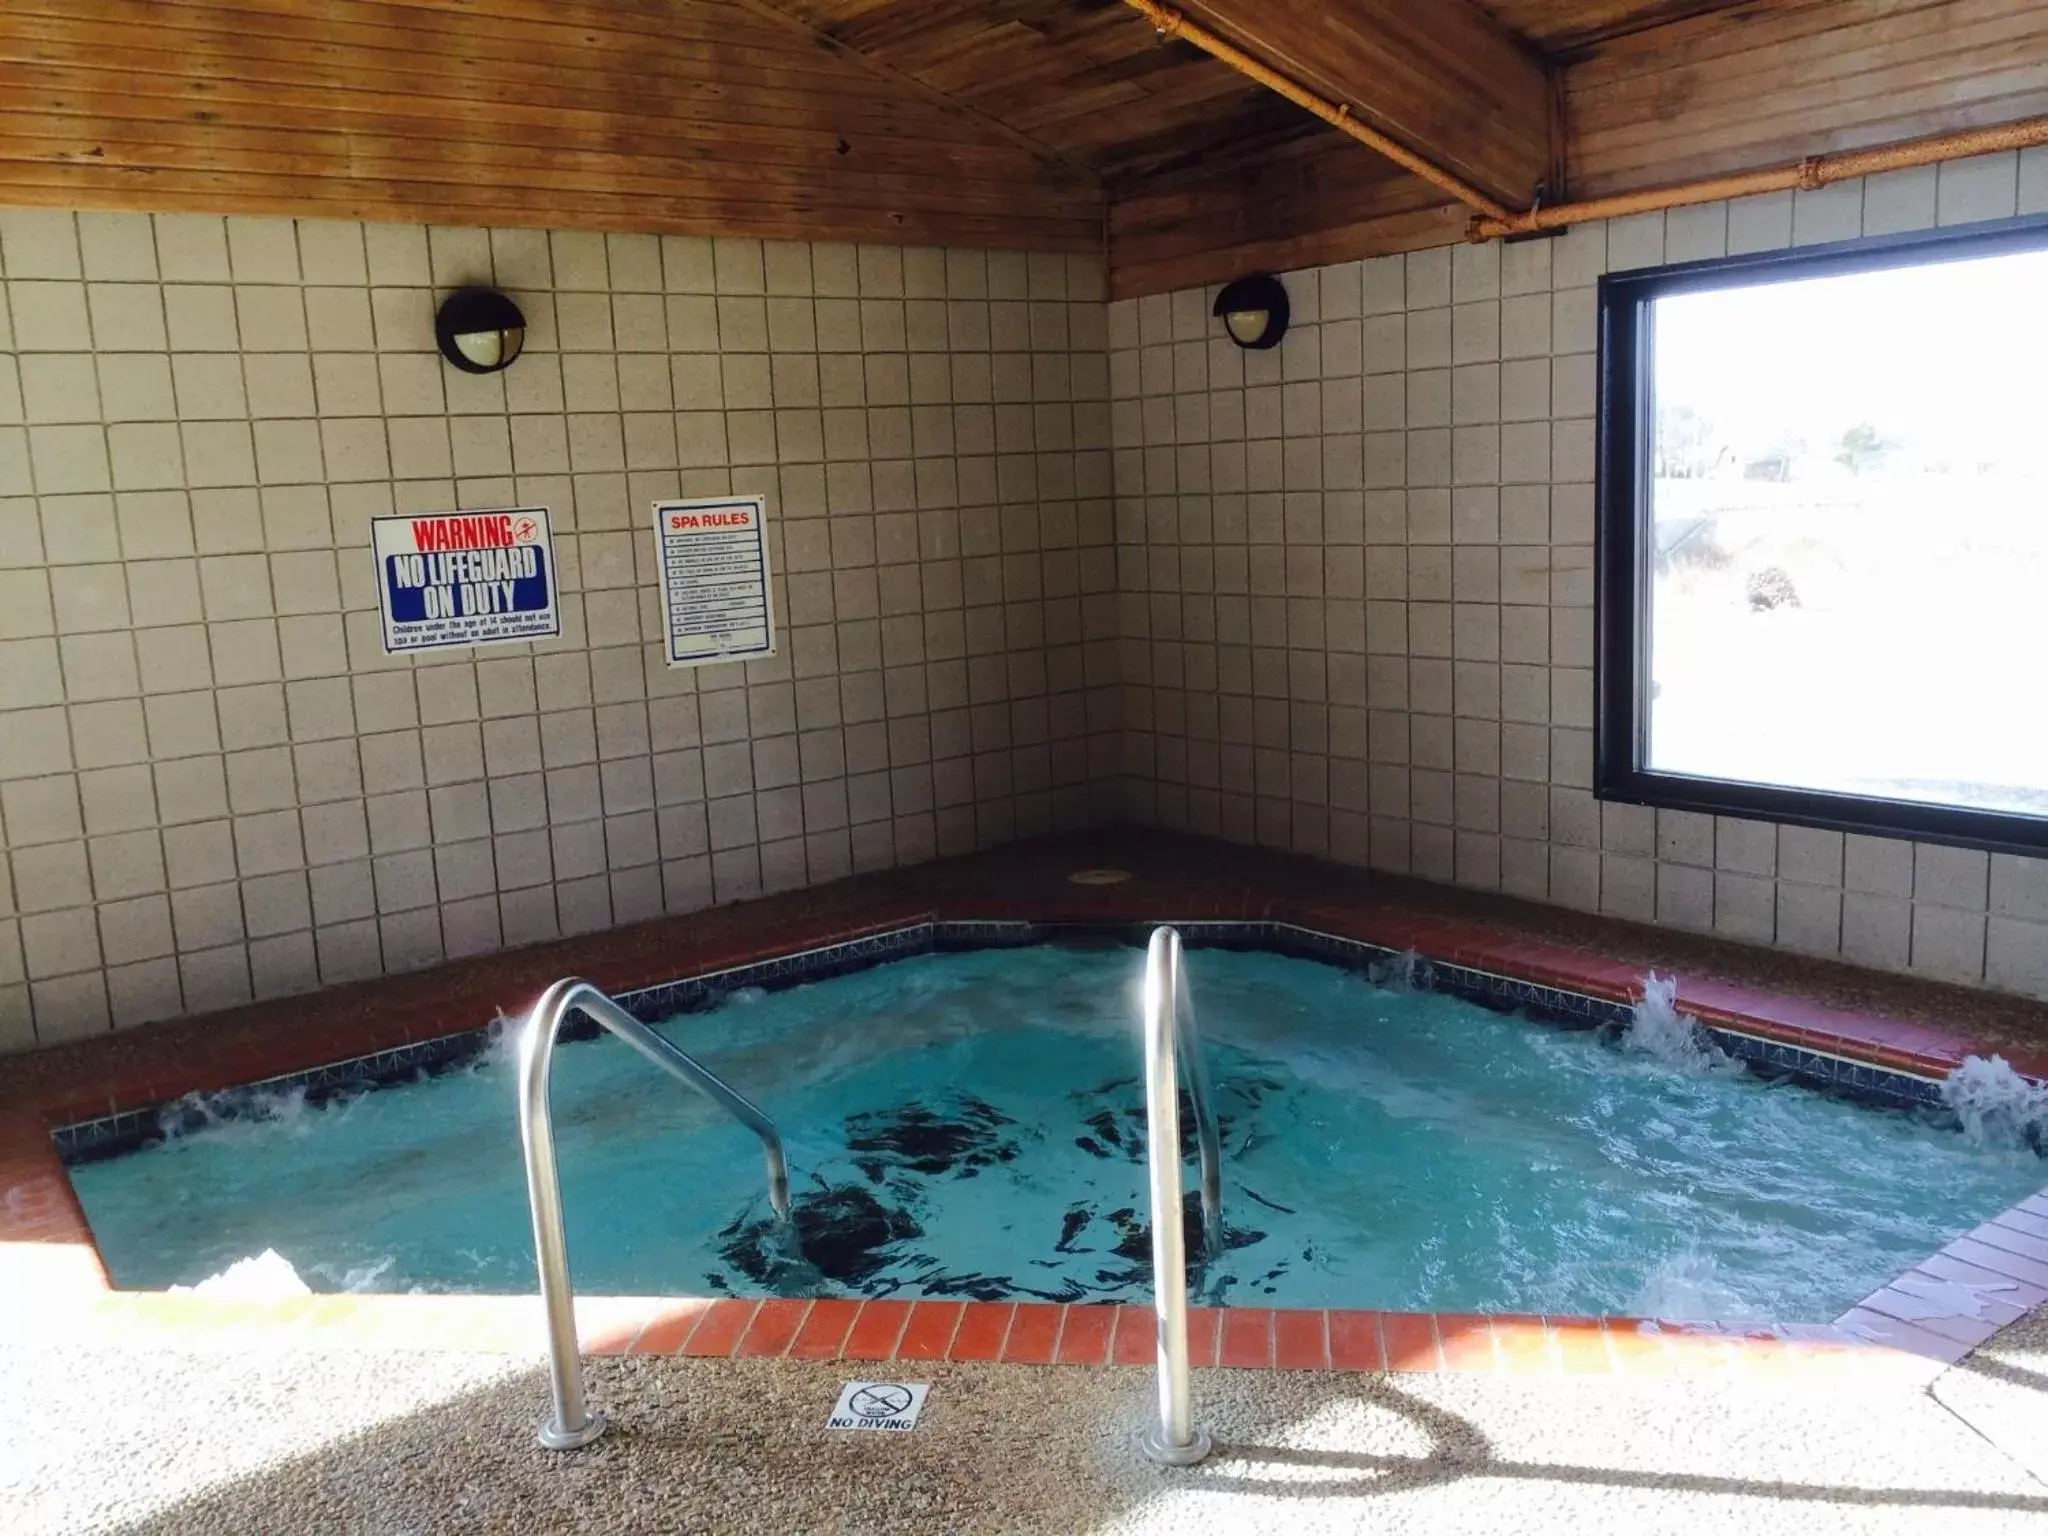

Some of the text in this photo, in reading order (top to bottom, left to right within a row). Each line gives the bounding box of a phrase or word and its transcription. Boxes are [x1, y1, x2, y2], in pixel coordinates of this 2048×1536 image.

[671, 512, 750, 530] SPA RULES
[412, 515, 514, 552] WARNING
[394, 547, 538, 588] NO LIFEGUARD
[422, 580, 516, 619] ON DUTY
[393, 624, 422, 634] Children
[425, 622, 445, 631] under
[449, 620, 461, 628] the
[479, 617, 487, 625] of
[500, 614, 522, 623] should
[525, 612, 536, 621] not
[421, 633, 437, 642] pool
[440, 630, 467, 640] without
[482, 627, 499, 635] adult
[829, 1417, 912, 1430] NO DIVING
